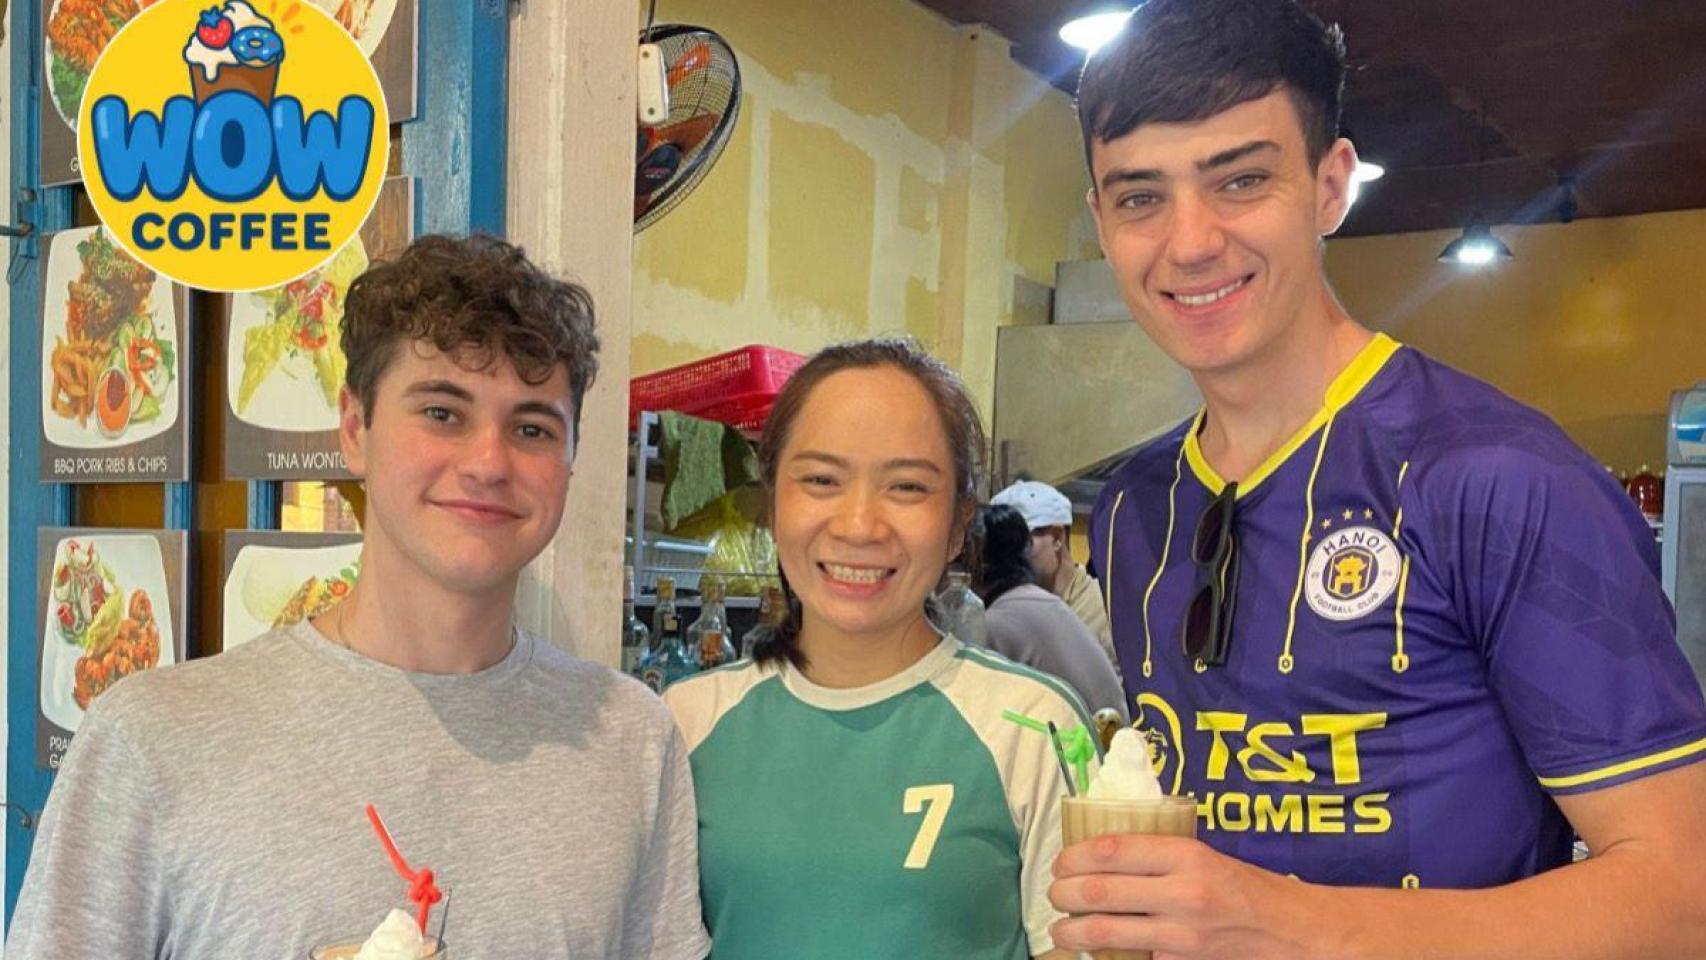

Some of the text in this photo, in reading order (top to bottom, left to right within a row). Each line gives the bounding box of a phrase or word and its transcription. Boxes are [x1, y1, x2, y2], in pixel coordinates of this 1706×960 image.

[54, 455, 167, 474] BBQ PORK RIBS & CHIPS
[267, 451, 299, 470] TUNA
[1323, 531, 1387, 555] HANOI
[1196, 711, 1388, 784] T&T
[902, 784, 955, 870] 7
